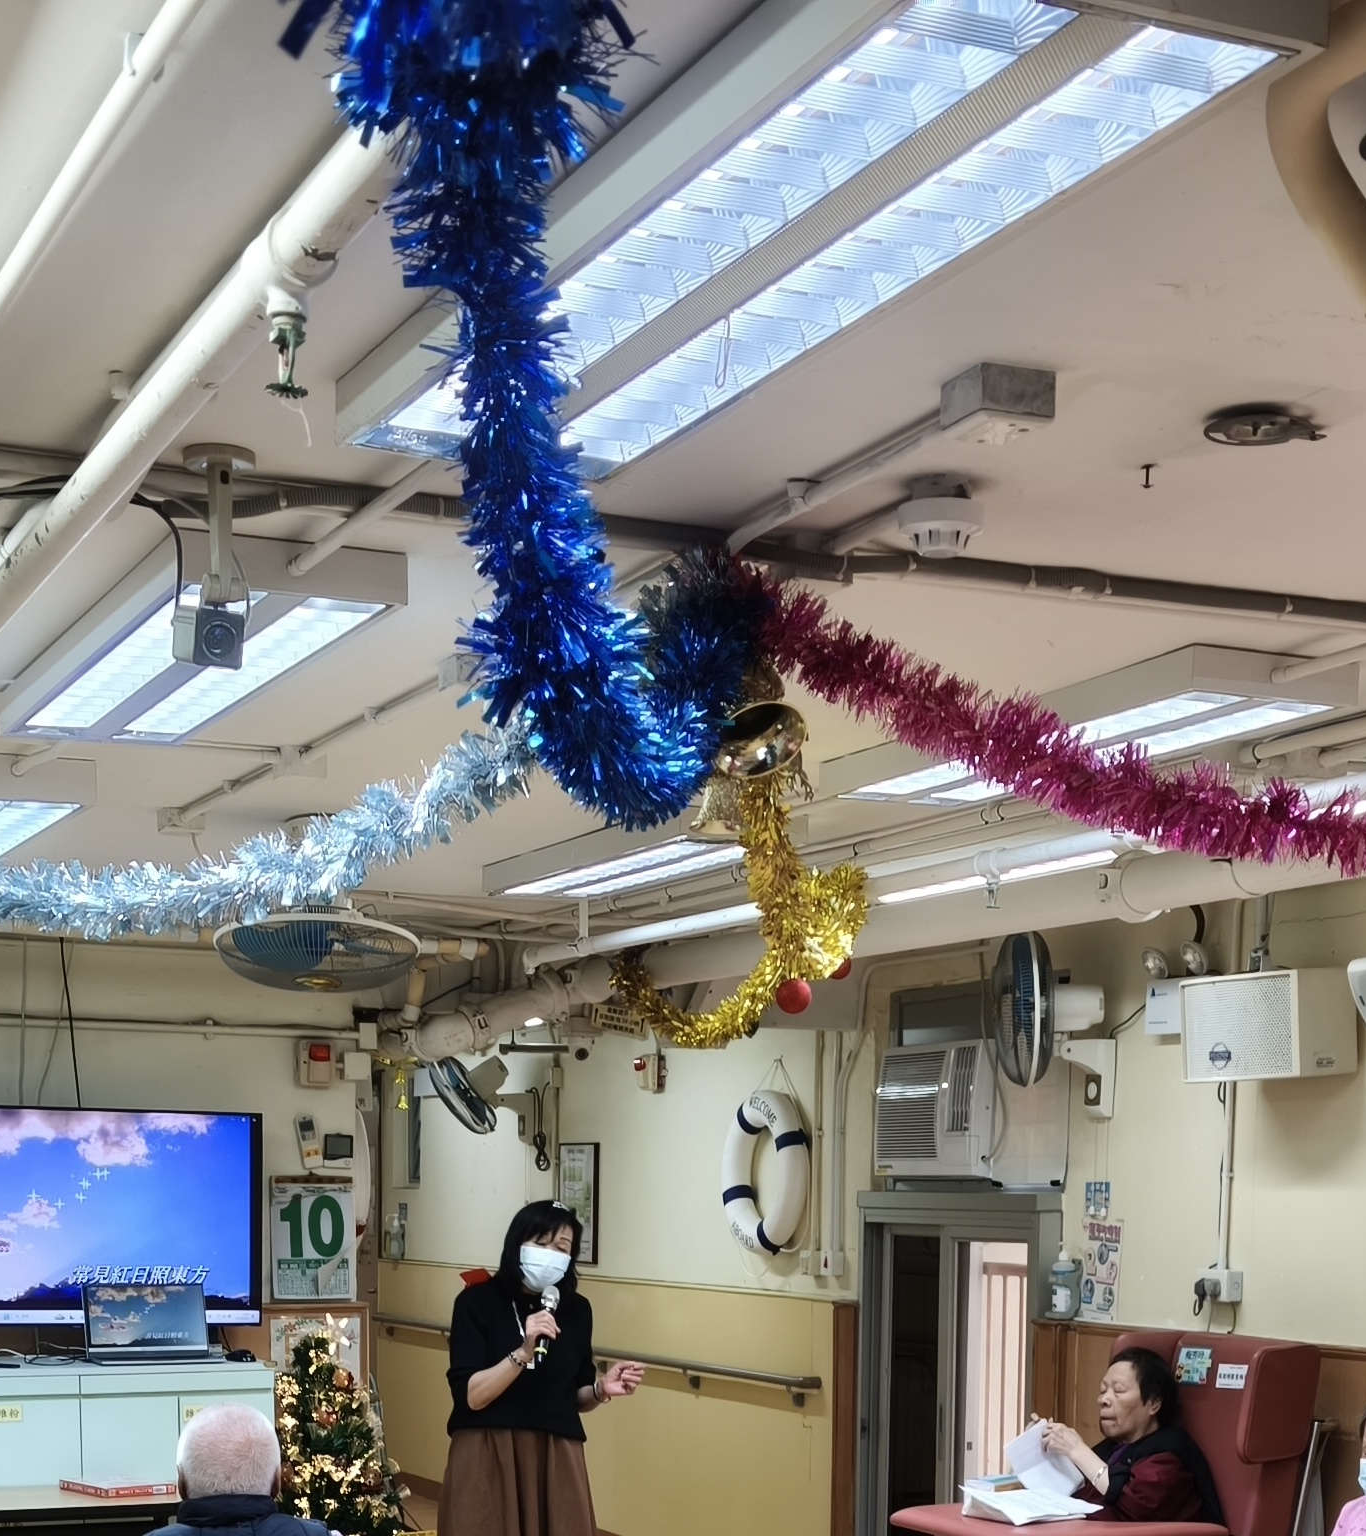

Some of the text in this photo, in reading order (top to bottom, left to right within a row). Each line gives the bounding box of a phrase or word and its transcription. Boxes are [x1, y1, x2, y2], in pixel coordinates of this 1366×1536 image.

[749, 1096, 778, 1128] WELCOME
[280, 1193, 344, 1257] 10
[731, 1221, 754, 1249] ABOARD
[68, 1264, 210, 1285] 常見紅日照東方
